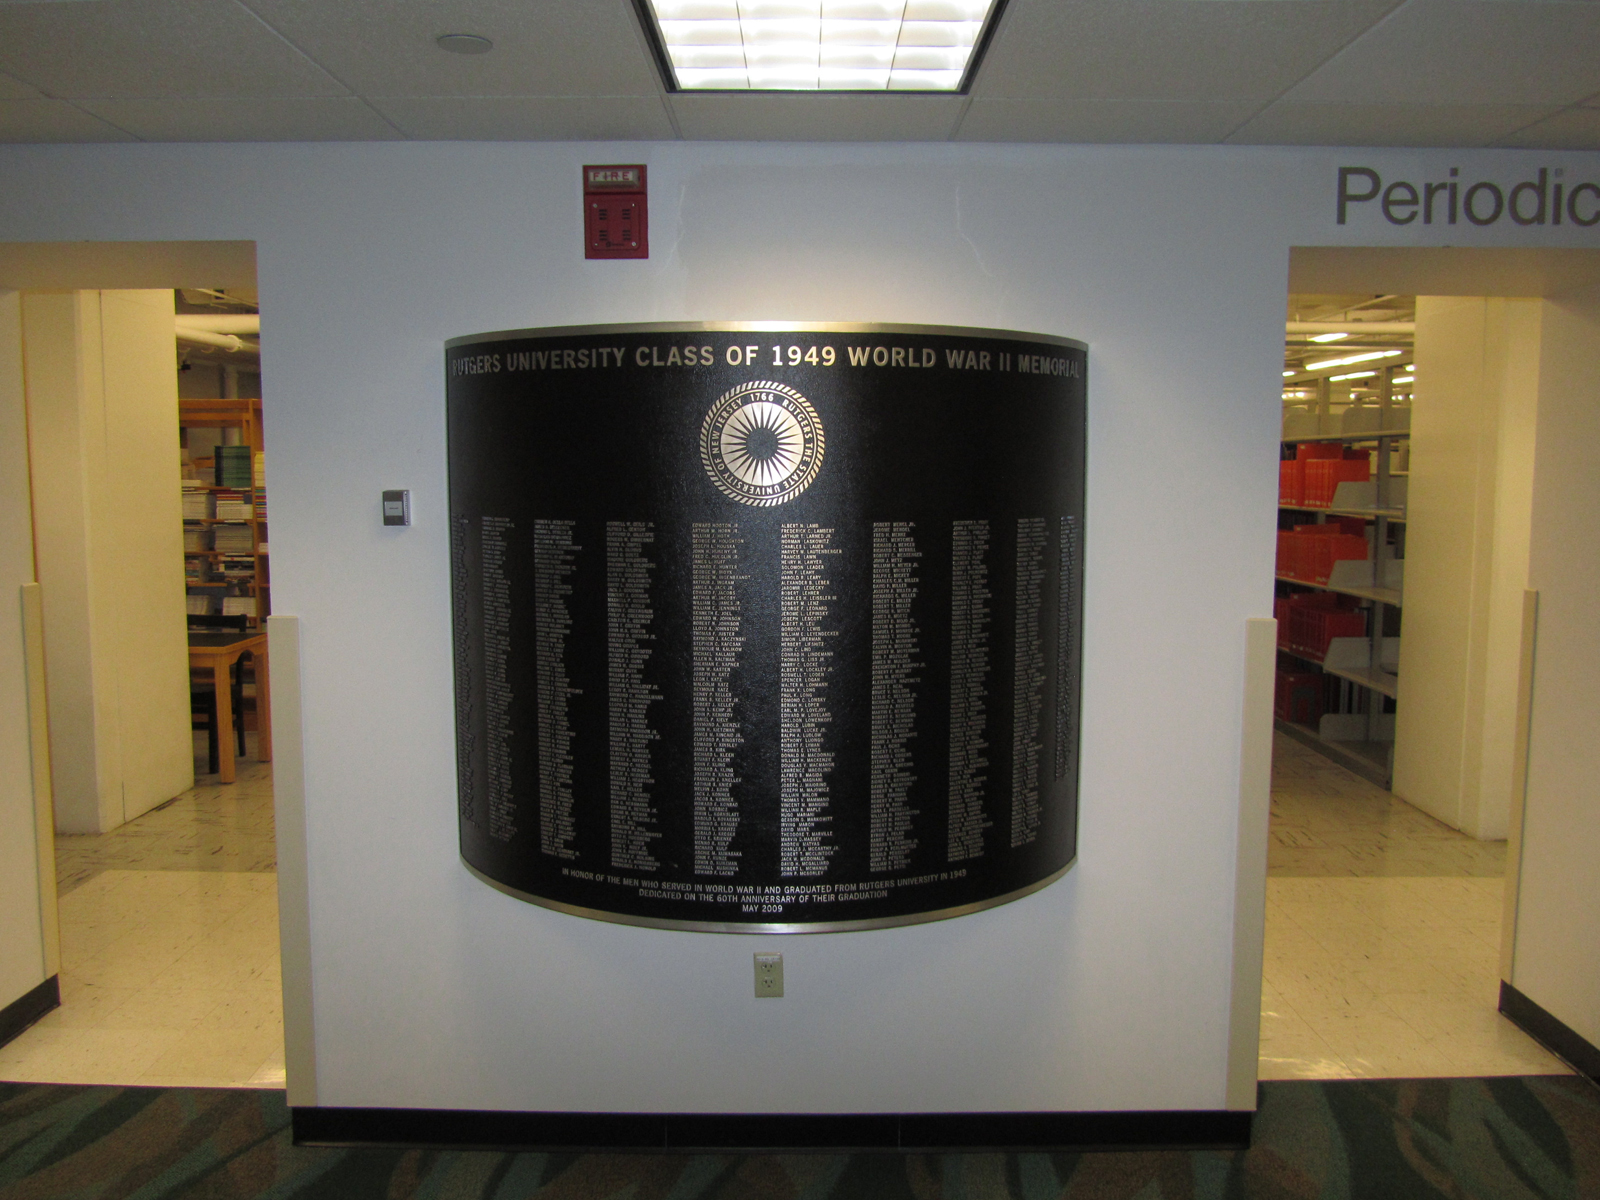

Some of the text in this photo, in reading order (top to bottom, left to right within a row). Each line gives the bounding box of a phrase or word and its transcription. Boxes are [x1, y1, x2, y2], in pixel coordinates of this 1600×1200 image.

[592, 171, 630, 181] FIRE
[1337, 166, 1600, 226] Periodic
[452, 346, 1079, 378] RUTGERS UNIVERSITY CLASS OF 1949 WORLD WAR II MEMORIAL
[750, 393, 774, 402] 1766
[712, 398, 813, 495] RUTGERS THE STATE UNIVERSITY OF NEW JERSEY
[570, 870, 594, 880] HONOR
[607, 874, 620, 884] THE
[623, 877, 639, 887] MEN
[641, 880, 658, 889] WHO
[662, 881, 691, 891] SERVED
[705, 884, 734, 893] WORLD
[736, 885, 754, 894] WAR
[764, 885, 781, 894] AND
[784, 884, 832, 894] GRADUATED
[835, 883, 856, 892] FROM
[859, 880, 895, 891] RUTGERS
[897, 874, 938, 887] UNIVERSITY
[950, 869, 967, 879] 1949
[638, 888, 888, 902] DEDICATED ON THE 60TH ANNIVERSARY OF THEIR GRADUATION
[742, 904, 759, 912] MAY
